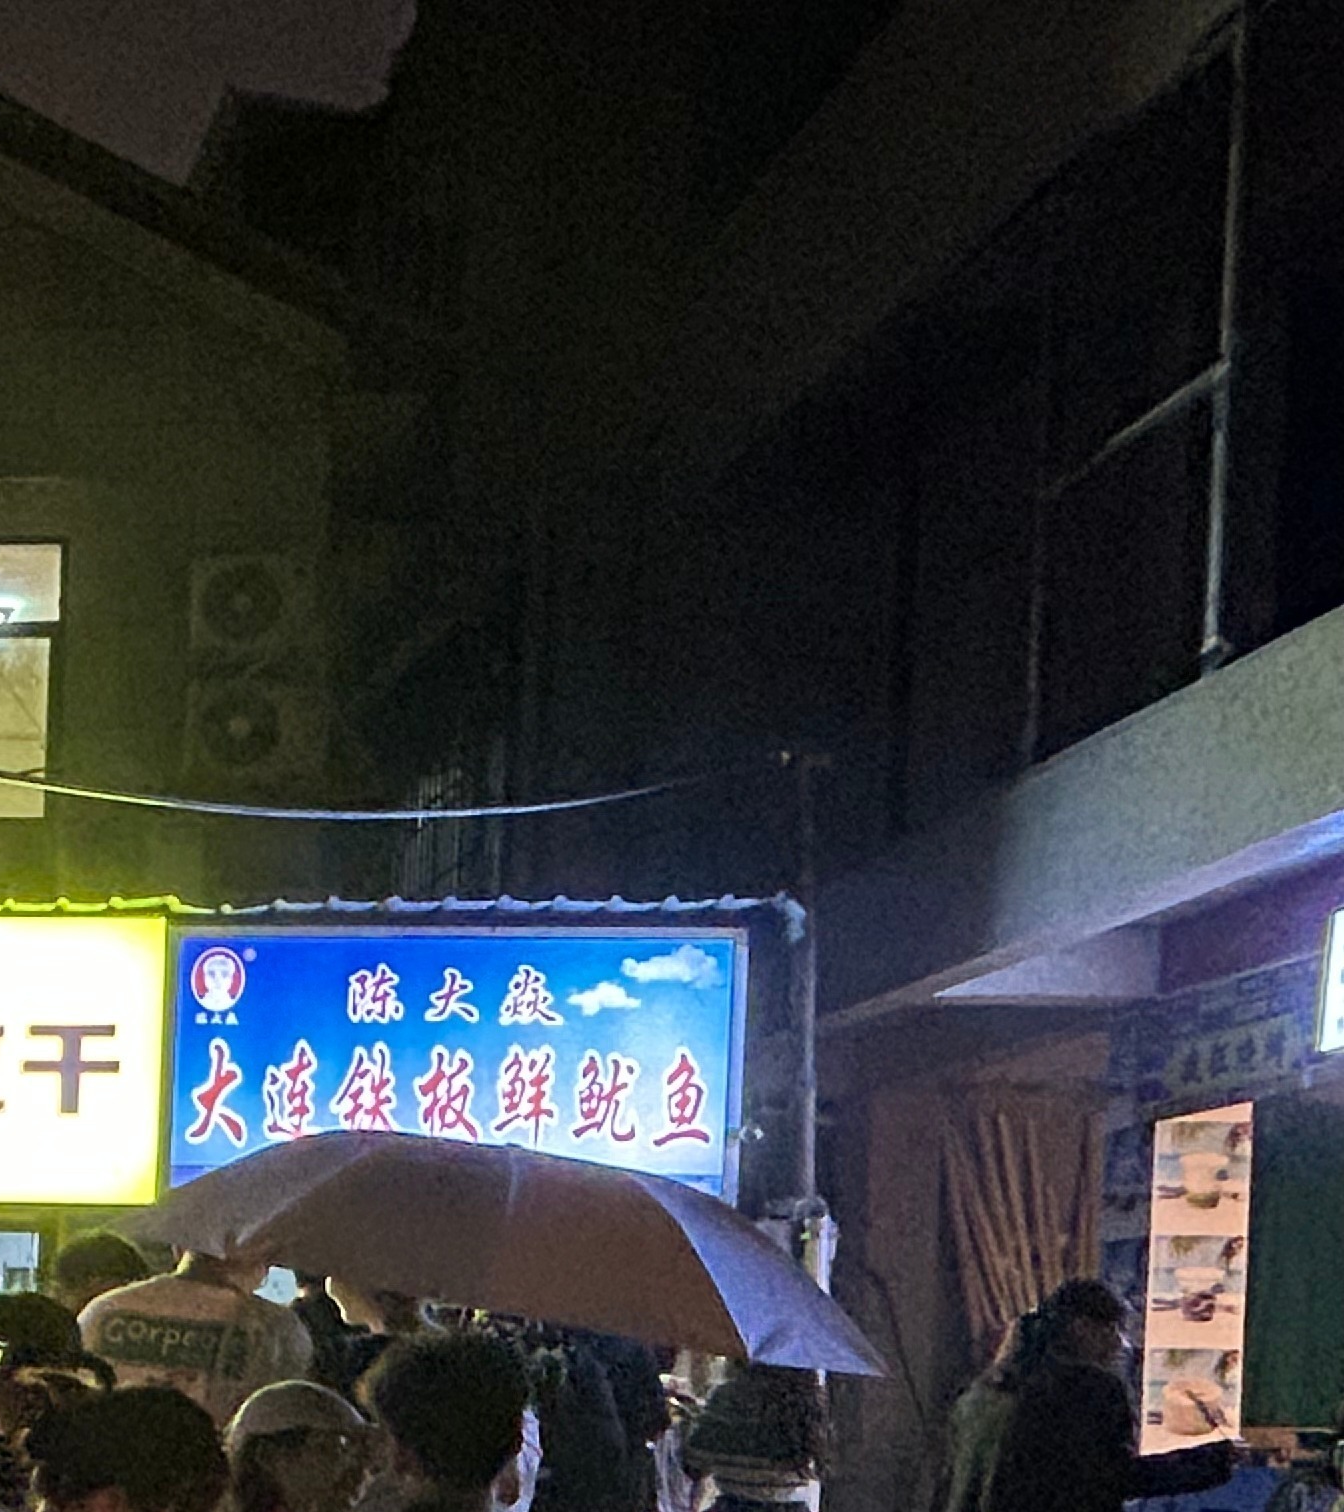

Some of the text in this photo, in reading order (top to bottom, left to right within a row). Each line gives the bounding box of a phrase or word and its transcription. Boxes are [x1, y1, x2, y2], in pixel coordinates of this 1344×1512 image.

[184, 1038, 712, 1149] 大连铁板鲜鱿鱼
